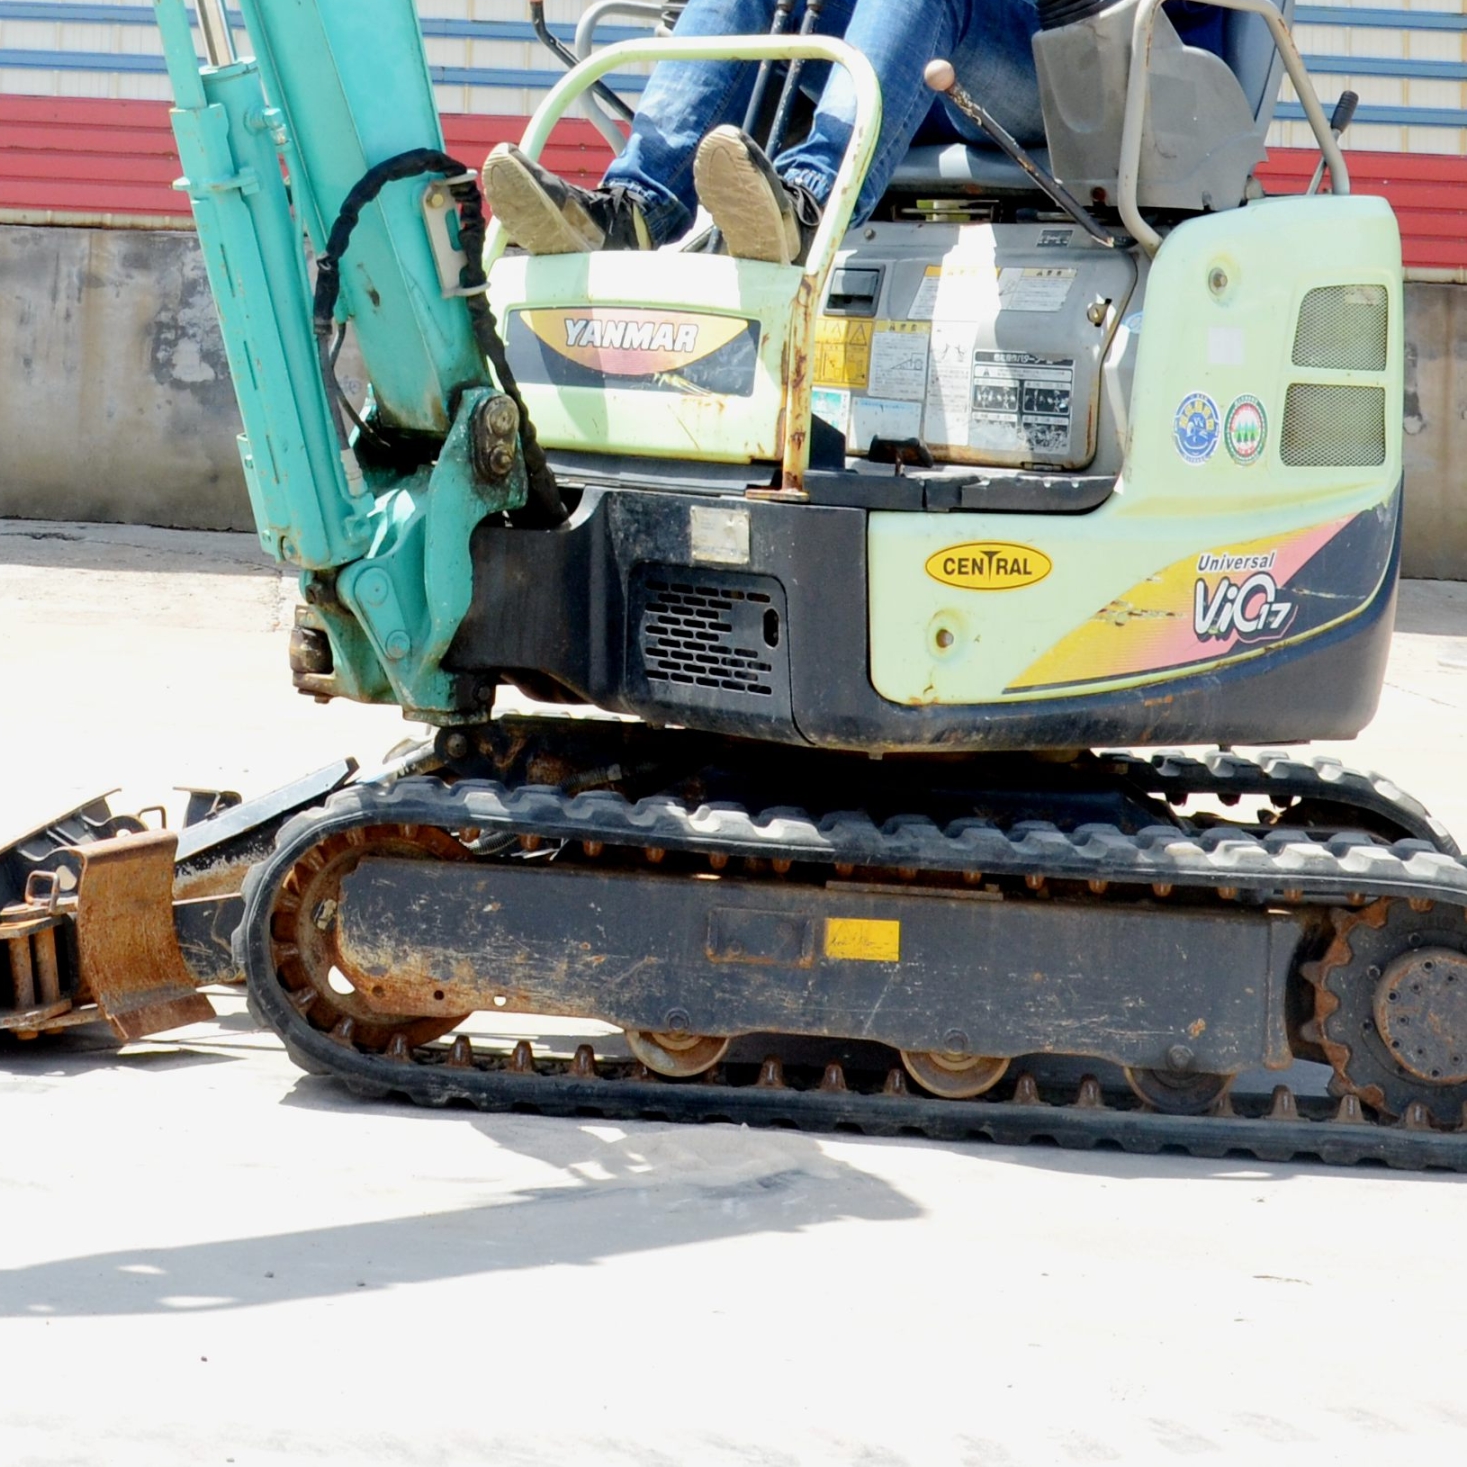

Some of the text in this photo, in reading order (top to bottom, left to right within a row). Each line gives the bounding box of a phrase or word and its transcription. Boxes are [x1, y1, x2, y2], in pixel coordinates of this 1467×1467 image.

[564, 318, 699, 353] YANMAR
[942, 550, 1033, 583] CENTRAL
[1197, 551, 1276, 572] Universal
